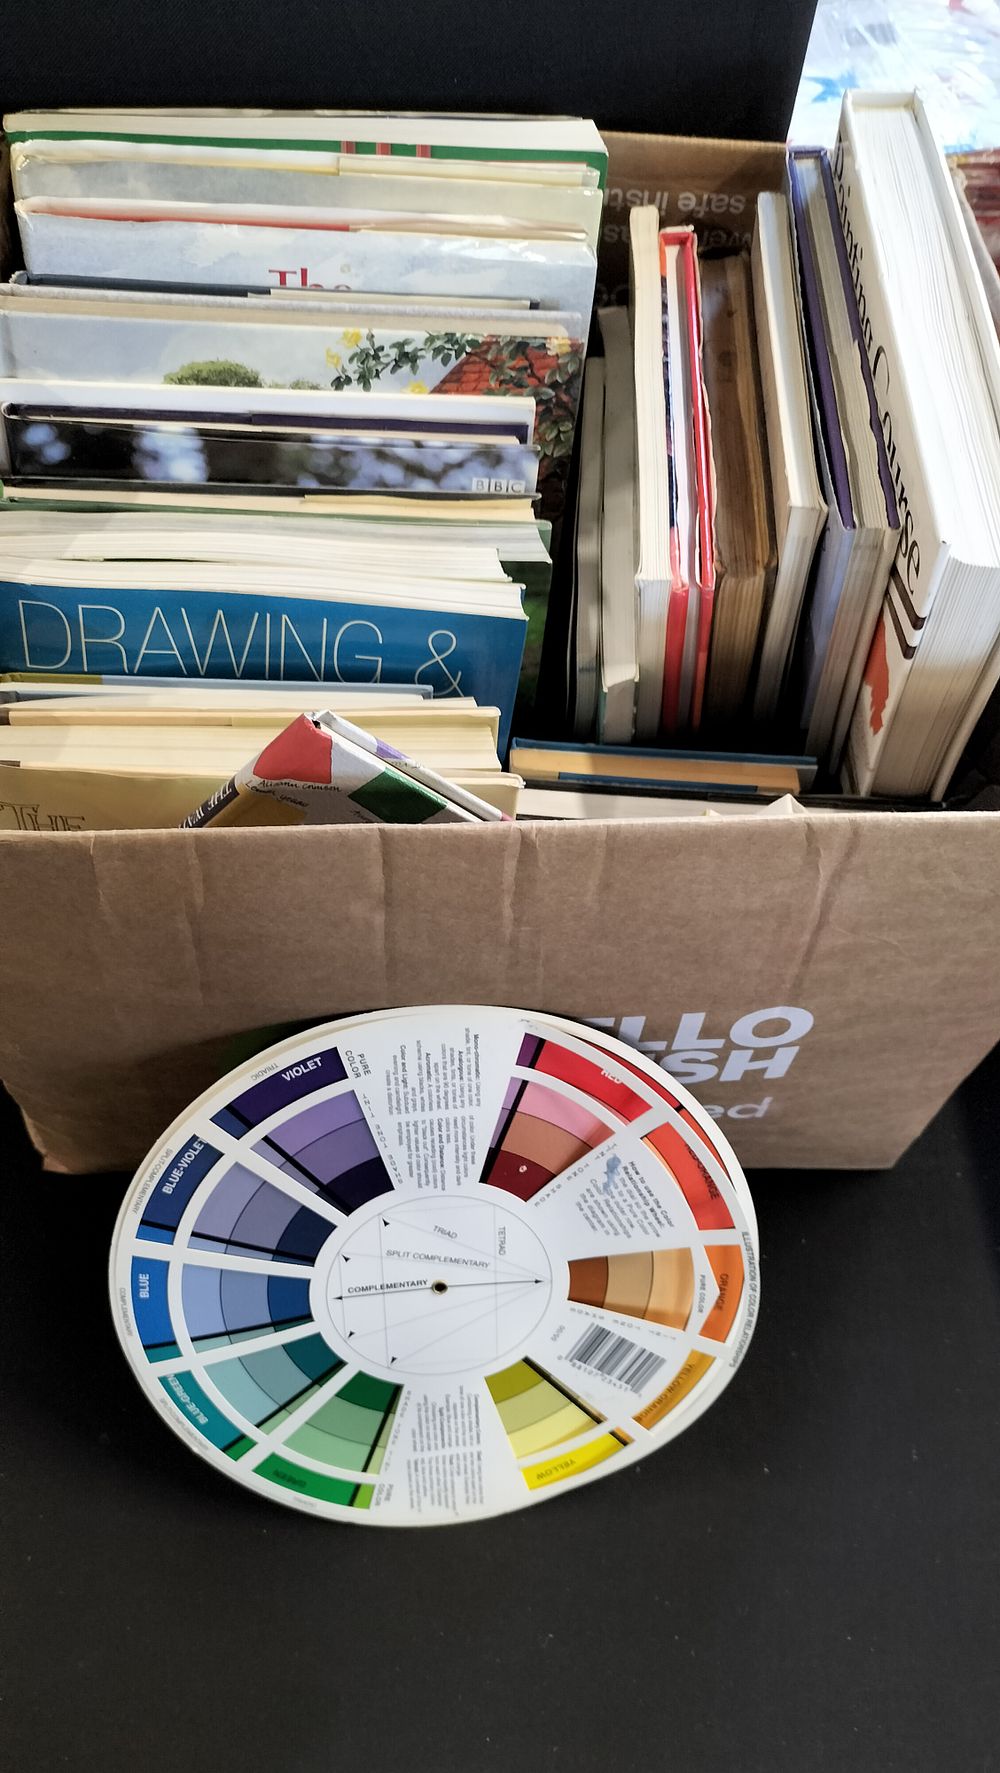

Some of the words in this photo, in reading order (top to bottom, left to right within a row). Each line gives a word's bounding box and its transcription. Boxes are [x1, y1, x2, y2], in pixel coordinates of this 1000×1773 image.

[677, 191, 746, 217] safe
[268, 268, 351, 289] Th
[873, 345, 921, 594] Course
[474, 479, 525, 493] BBC
[18, 599, 384, 684] DRAWING
[414, 629, 464, 698] &
[583, 1006, 815, 1051] LLO
[281, 1056, 323, 1083] VIOLET
[345, 1050, 361, 1079] COLOR
[357, 1053, 372, 1076] PURE
[645, 1046, 800, 1085] SH
[621, 1165, 651, 1207] Relationship
[628, 1160, 641, 1176] How
[644, 1184, 655, 1198] use
[652, 1197, 663, 1210] the
[660, 1208, 676, 1229] Color
[433, 1224, 458, 1240] TRIAD
[499, 1226, 507, 1256] TETRAD
[386, 1249, 411, 1259] SPLIT
[412, 1251, 490, 1269] COMPLEMENTARY
[139, 1273, 150, 1299] BLUE
[347, 1279, 428, 1294] COMPLEMENTARY
[536, 1459, 576, 1480] YELLOW
